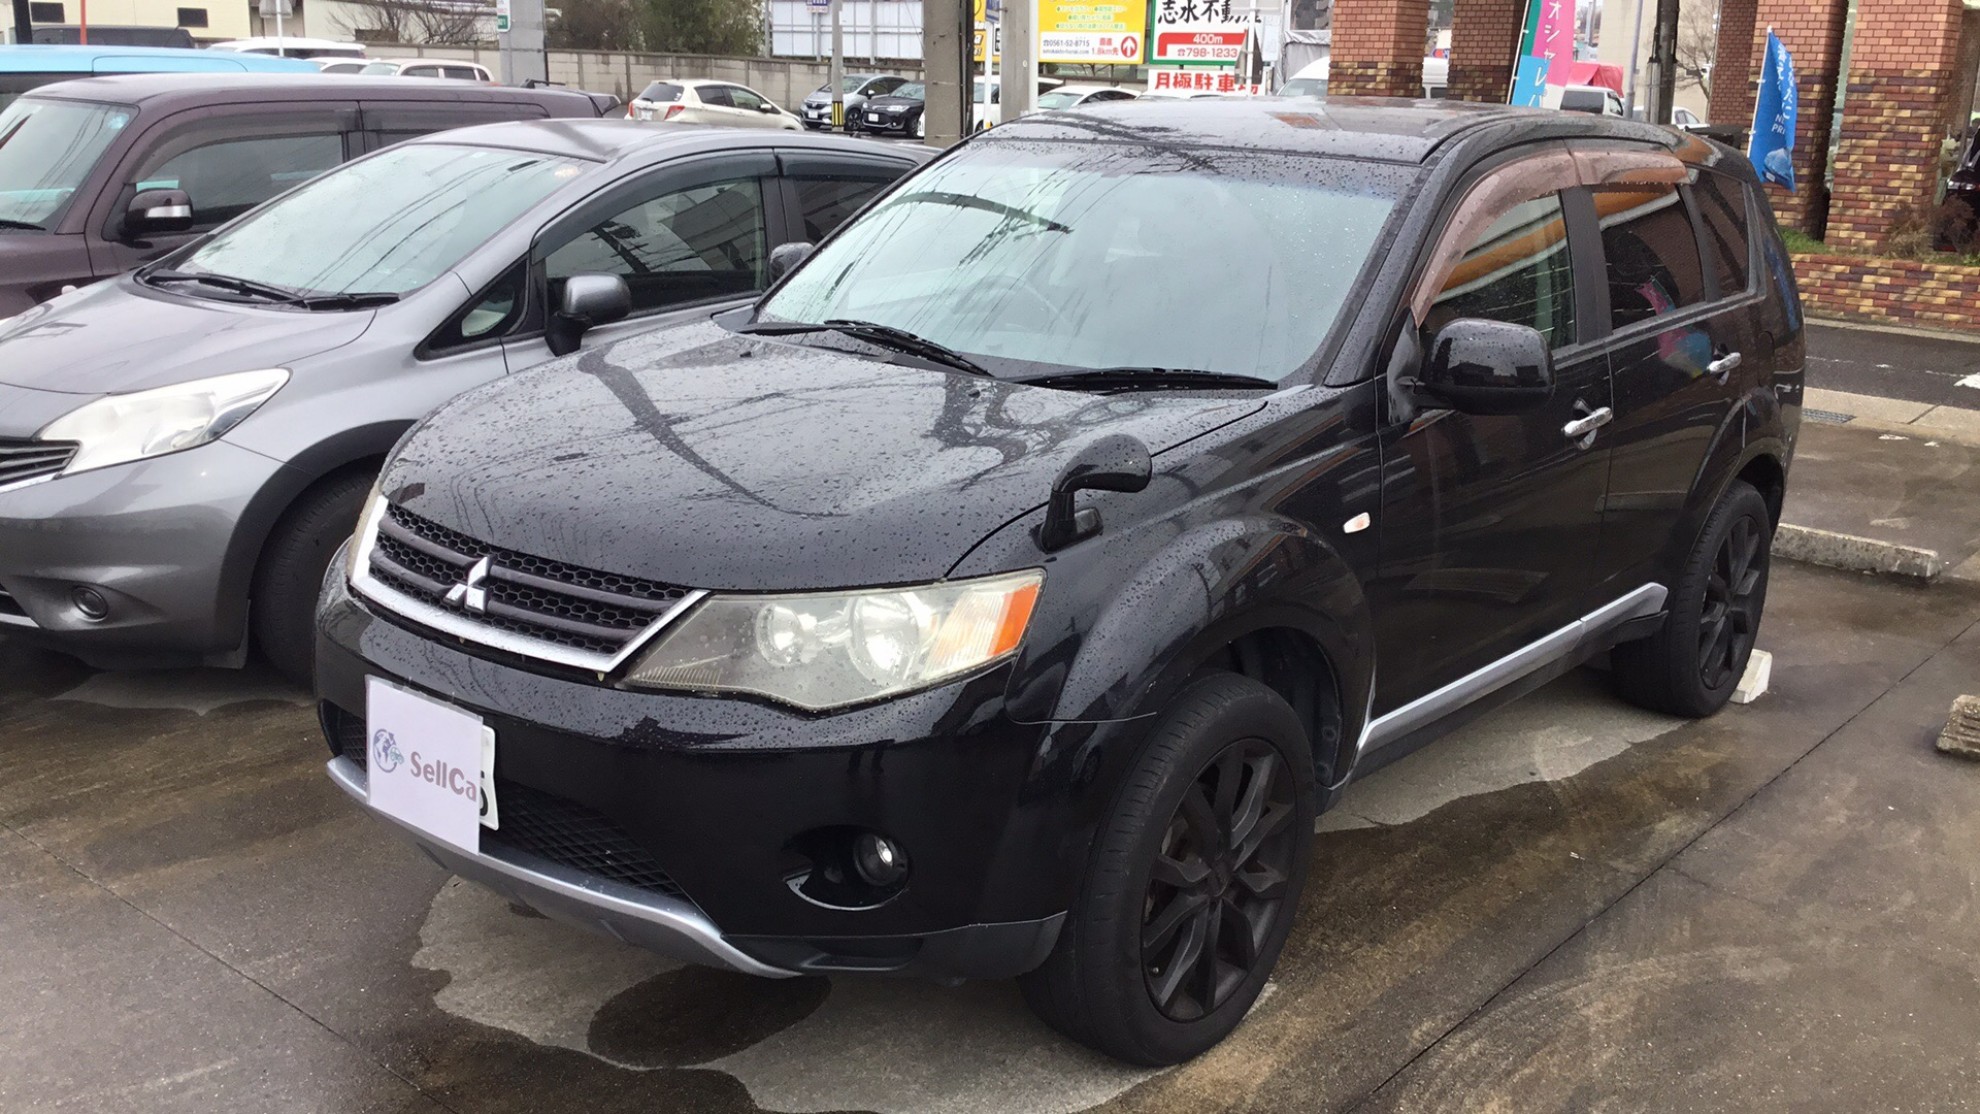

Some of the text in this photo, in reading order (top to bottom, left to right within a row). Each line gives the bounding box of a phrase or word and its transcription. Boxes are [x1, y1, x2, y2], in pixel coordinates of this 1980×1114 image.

[1192, 33, 1223, 44] 400m
[1186, 48, 1238, 58] 798-1233
[410, 751, 477, 802] SellCa
